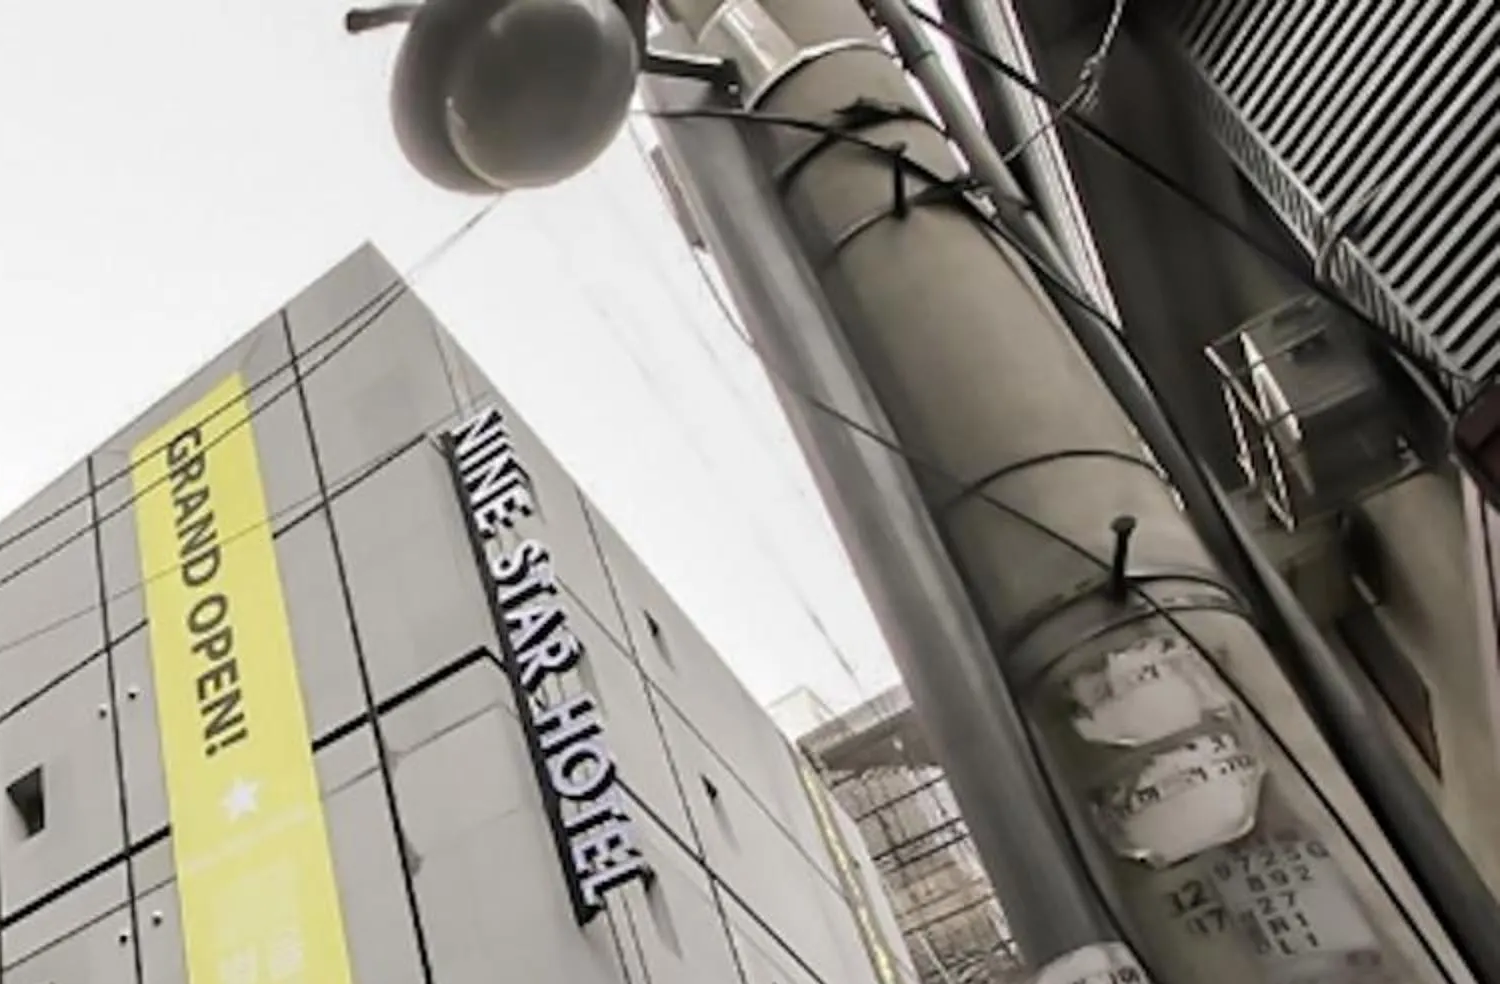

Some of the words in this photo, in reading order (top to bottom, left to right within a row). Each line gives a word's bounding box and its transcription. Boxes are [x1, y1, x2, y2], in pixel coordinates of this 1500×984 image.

[165, 425, 224, 588] GRAND
[451, 408, 532, 540] NINE
[187, 594, 249, 758] OPEN!
[491, 538, 583, 693] STAR
[536, 699, 655, 910] HOTEL
